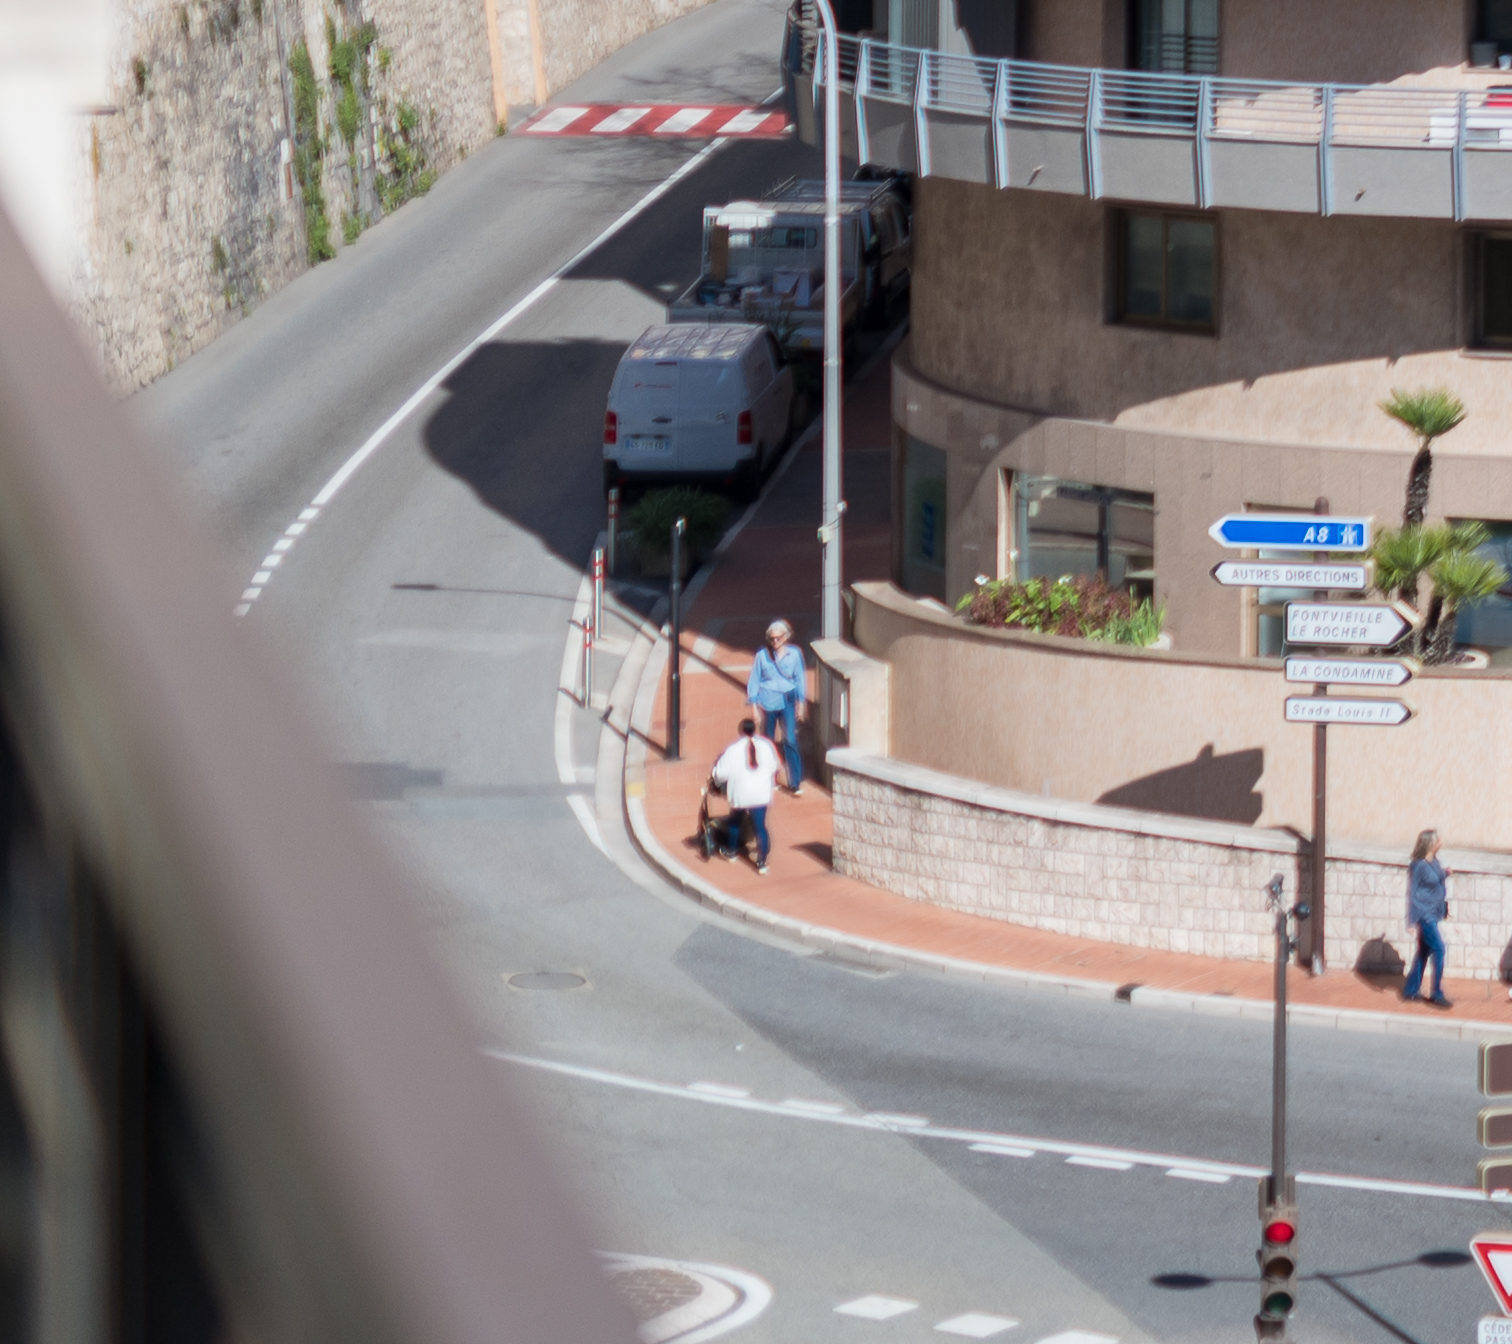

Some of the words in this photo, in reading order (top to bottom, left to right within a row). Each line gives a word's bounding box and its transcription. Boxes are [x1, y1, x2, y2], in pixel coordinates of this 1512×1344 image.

[1303, 525, 1330, 543] A8
[1231, 568, 1280, 581] AUTRES
[1285, 569, 1359, 583] DIRECTIONS
[1291, 609, 1383, 624] FONTVIEILLE
[1291, 625, 1306, 637] LE
[1313, 626, 1368, 639] ROCHER
[1291, 665, 1308, 677] LA
[1314, 666, 1394, 680] CONDAMINE
[1293, 703, 1330, 716] Stade
[1338, 705, 1373, 718] Louis
